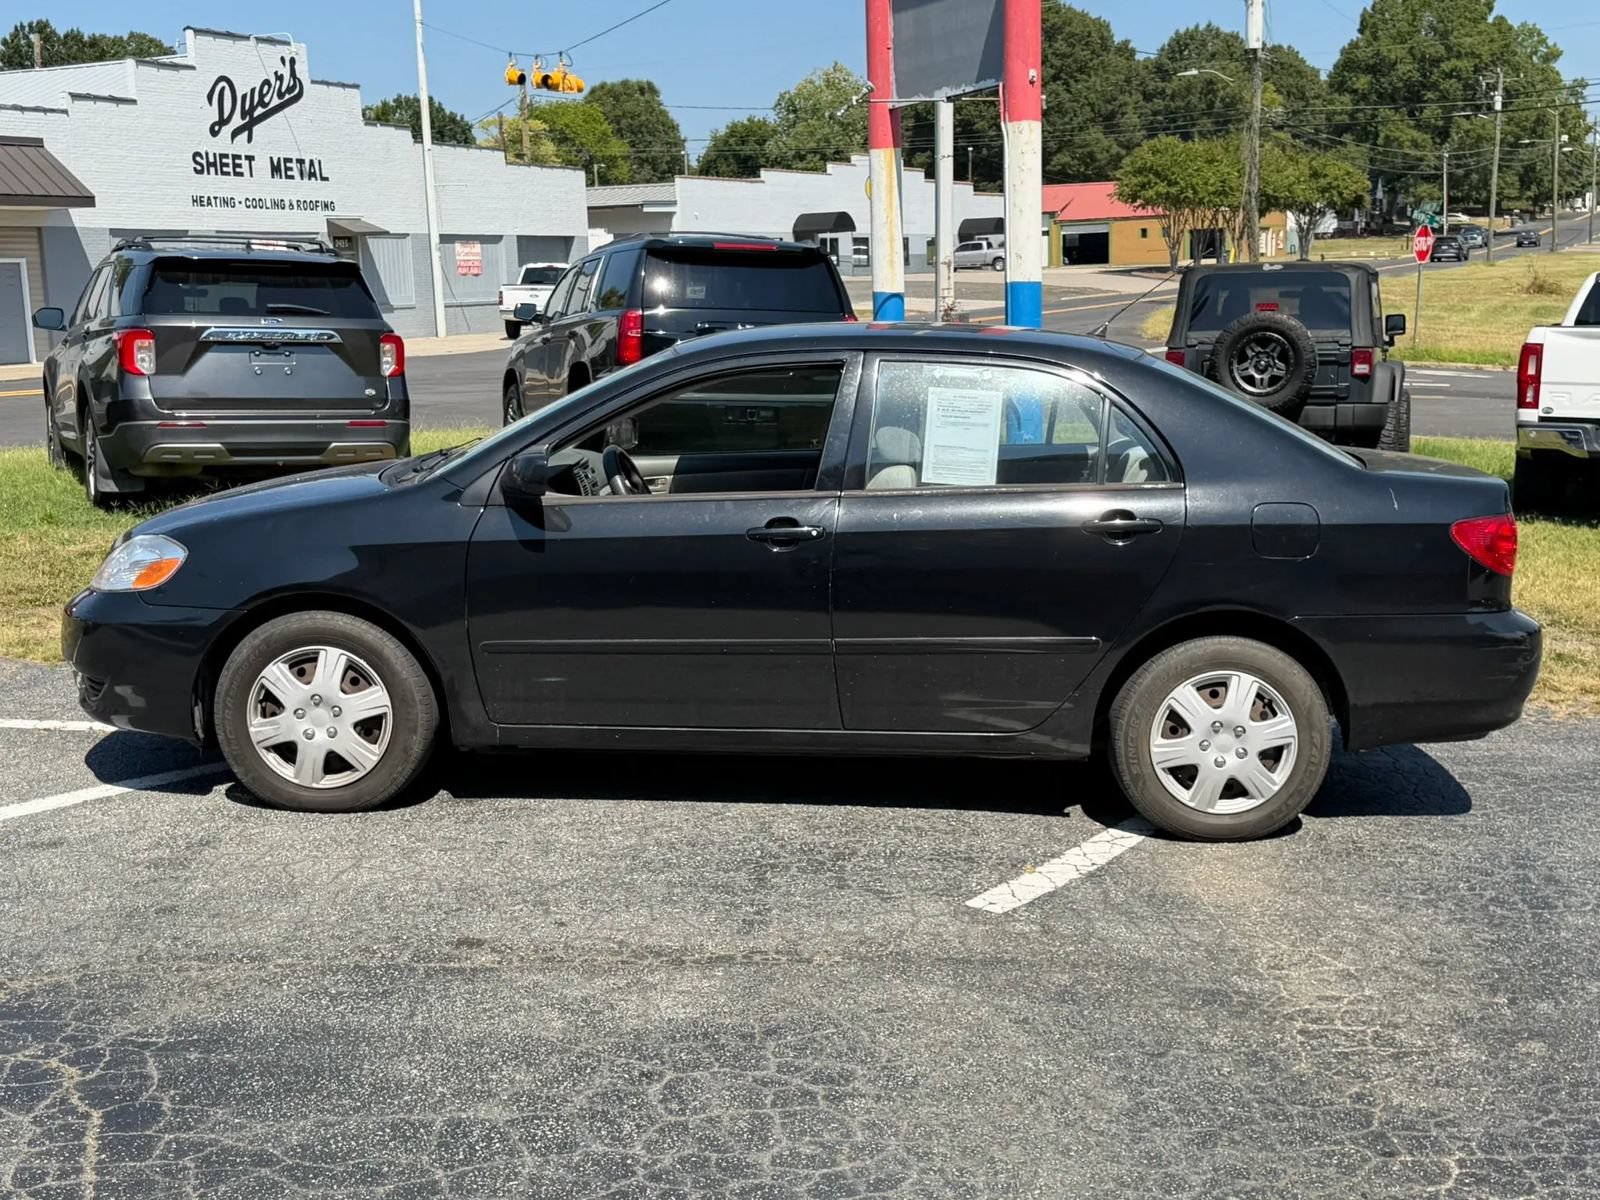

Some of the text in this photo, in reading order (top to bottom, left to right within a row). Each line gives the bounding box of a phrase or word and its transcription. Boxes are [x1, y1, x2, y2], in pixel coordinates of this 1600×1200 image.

[206, 56, 304, 144] Dyer's
[192, 150, 330, 181] SHEET METAL
[191, 195, 236, 209] HEATING
[244, 197, 286, 210] COOLING
[296, 200, 336, 212] ROOFING
[1415, 236, 1431, 251] STOP
